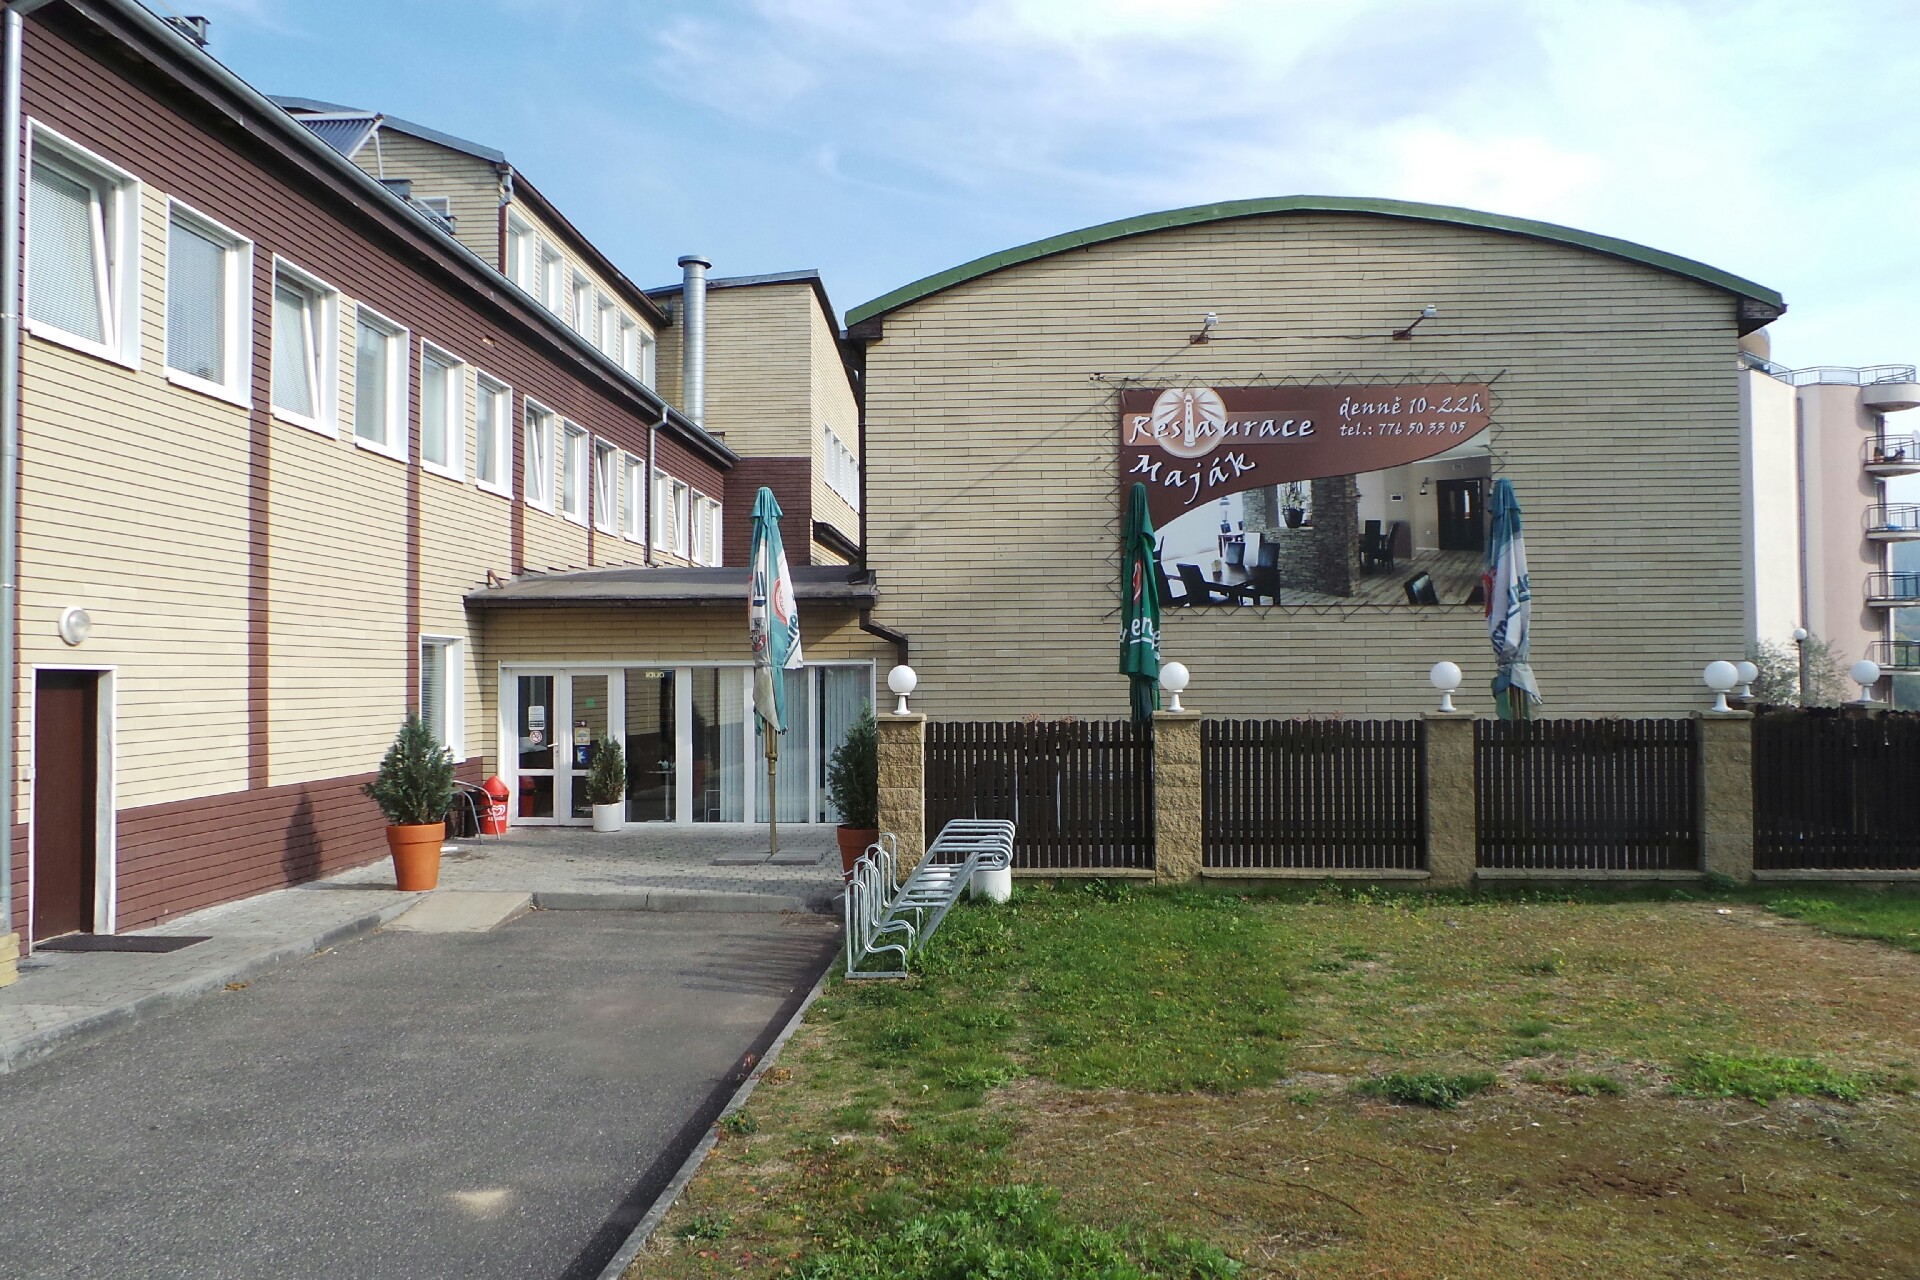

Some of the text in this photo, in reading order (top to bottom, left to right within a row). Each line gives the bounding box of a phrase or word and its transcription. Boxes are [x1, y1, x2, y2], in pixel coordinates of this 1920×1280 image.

[1339, 393, 1484, 421] denně 10-22h
[1340, 420, 1468, 437] tel.: 776 50 33 05
[1128, 451, 1256, 505] Maják
